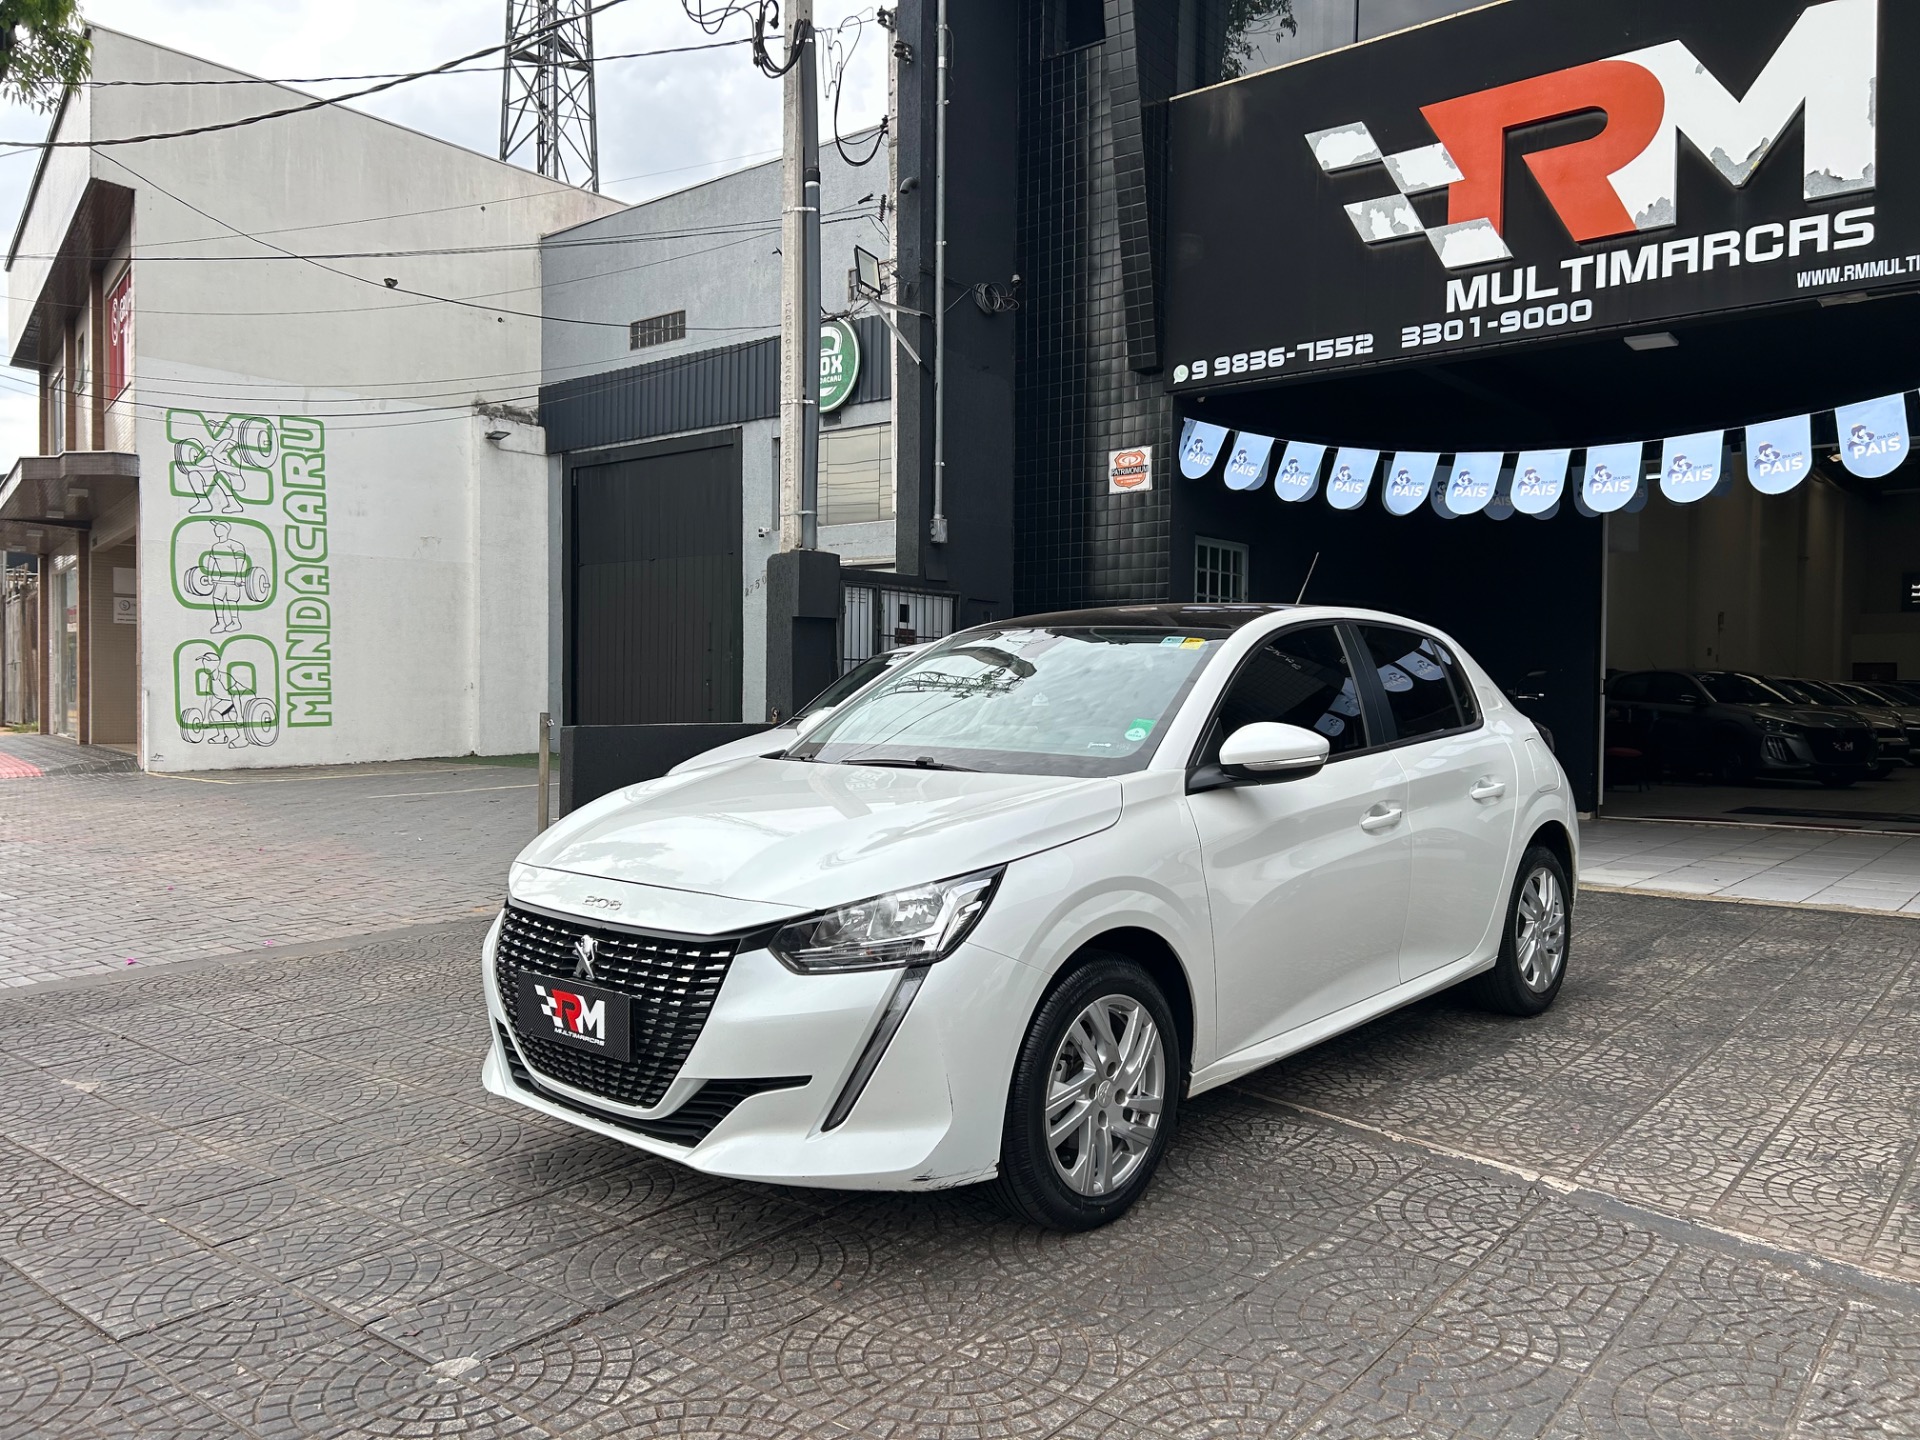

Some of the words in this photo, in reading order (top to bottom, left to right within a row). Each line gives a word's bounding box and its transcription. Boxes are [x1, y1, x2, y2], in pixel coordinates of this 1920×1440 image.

[1420, 0, 1877, 243] RM
[1447, 206, 1875, 313] MULTIMARCAS
[1401, 298, 1593, 349] 3301-9000
[1191, 358, 1208, 380] 9
[1213, 332, 1374, 376] 9836-7552
[820, 354, 843, 376] OX
[820, 374, 842, 385] DACARU
[1853, 437, 1901, 459] PAIS
[1187, 452, 1212, 466] PAIS
[1759, 456, 1804, 477] PAIS
[1111, 465, 1148, 476] PATRIMONIUM
[1230, 463, 1257, 477] PAIS
[1671, 468, 1713, 485] PAIS
[1281, 473, 1310, 486] PAIS
[1334, 481, 1364, 494] PAIS
[1592, 479, 1632, 495] PAIS
[1393, 485, 1424, 497] PAIS
[1453, 485, 1488, 498] PAIS
[1520, 484, 1557, 497] PAIS
[166, 408, 280, 733] BOX
[280, 416, 332, 728] MANDACARU
[582, 895, 623, 911] 208
[551, 989, 605, 1040] RM
[554, 1027, 605, 1047] MULTIMARCAS
